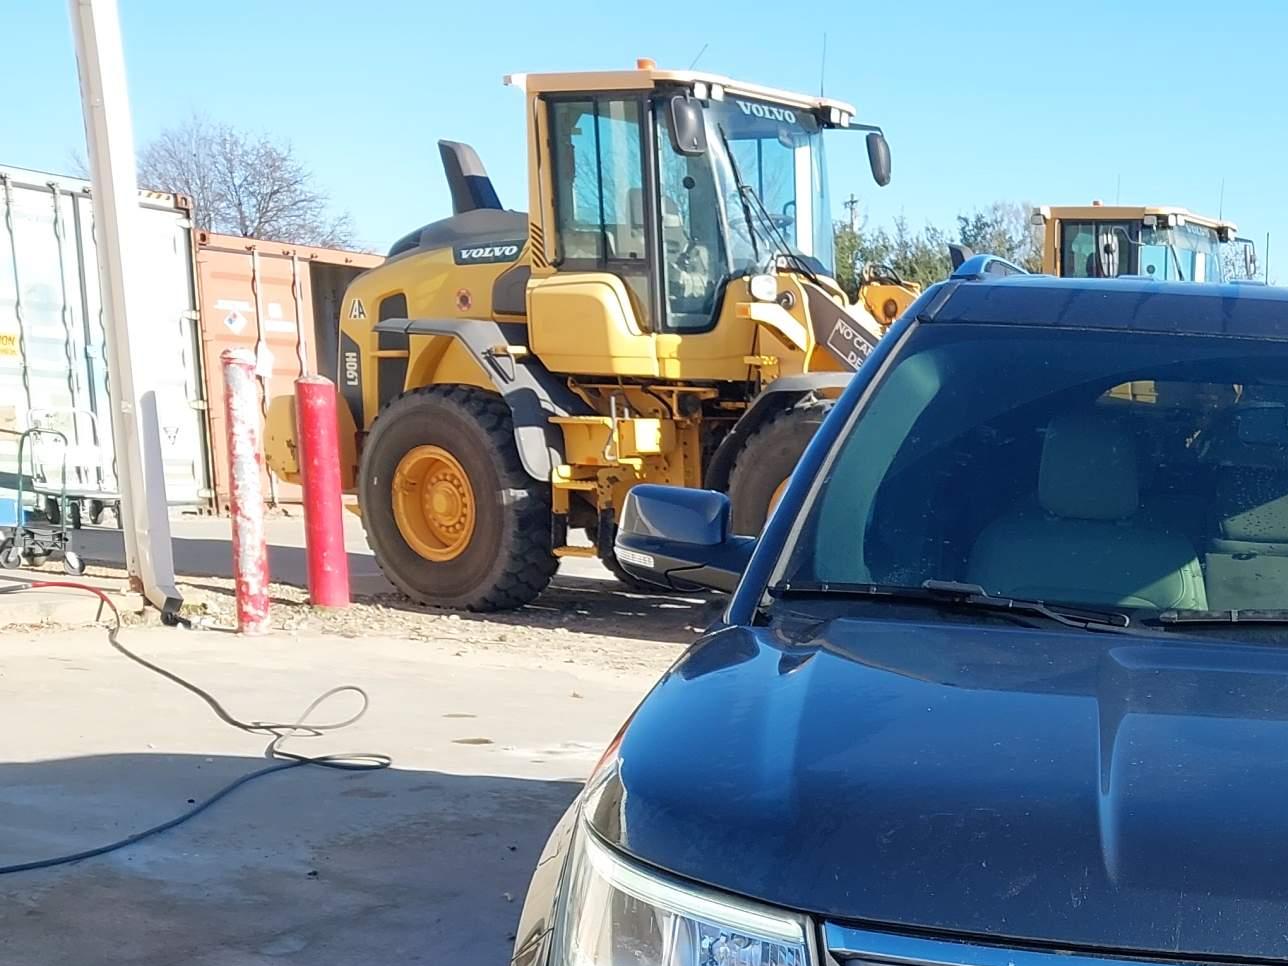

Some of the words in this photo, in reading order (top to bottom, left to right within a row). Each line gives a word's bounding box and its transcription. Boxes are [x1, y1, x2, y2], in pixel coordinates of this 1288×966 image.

[735, 100, 797, 124] VOLVO
[461, 245, 519, 259] VOLVO
[835, 320, 853, 340] NO
[0, 335, 16, 346] ON
[345, 352, 358, 386] L90H
